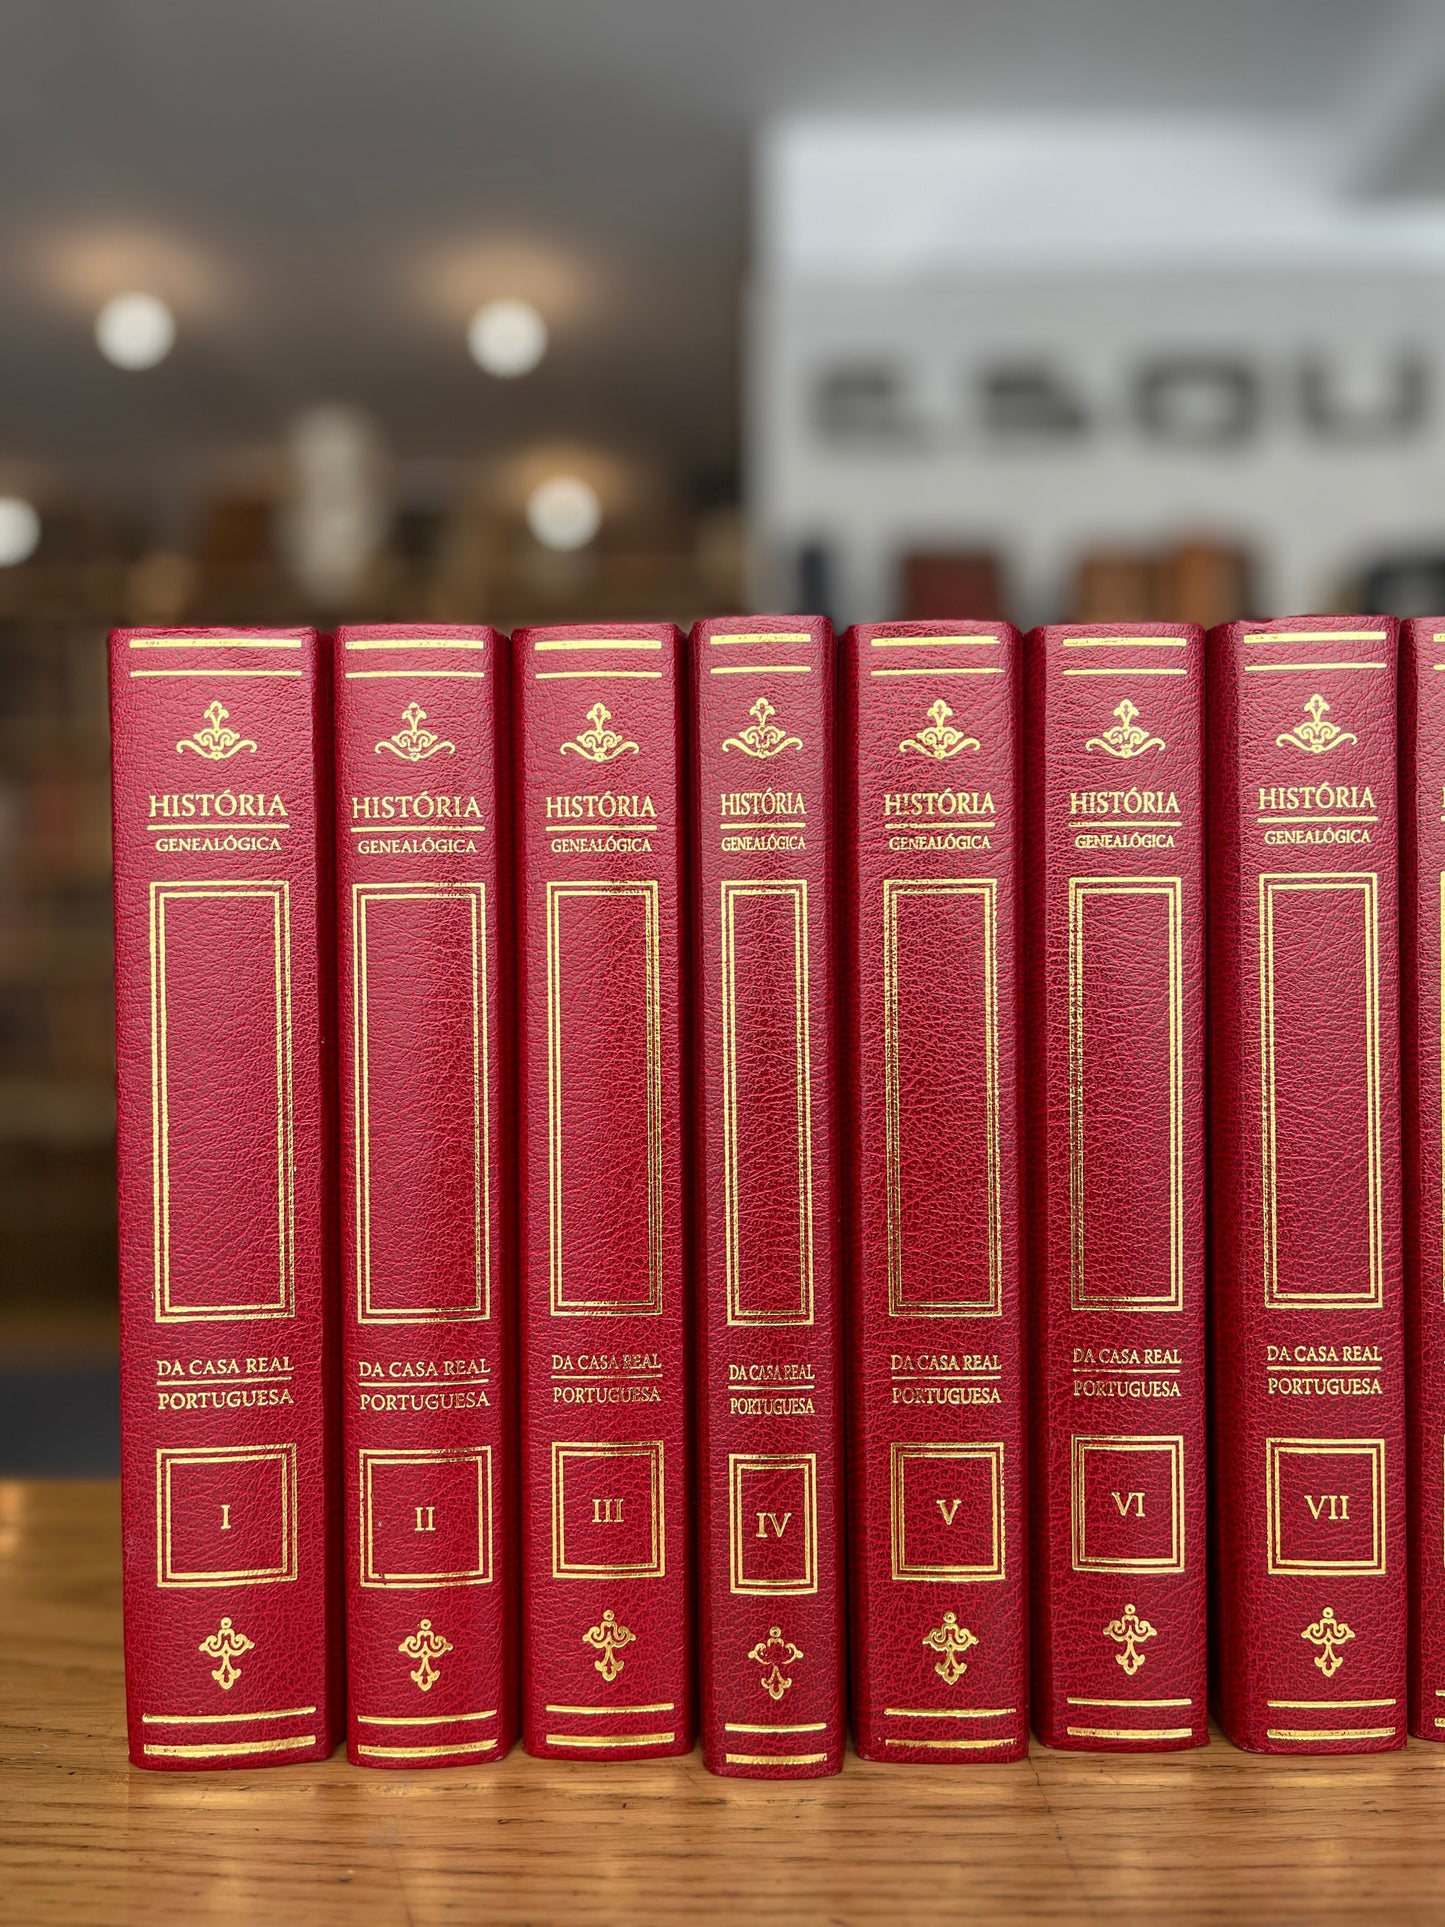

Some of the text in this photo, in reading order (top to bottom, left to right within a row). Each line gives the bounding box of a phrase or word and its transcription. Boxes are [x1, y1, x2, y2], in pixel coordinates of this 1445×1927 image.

[149, 790, 288, 817] HISTÓRIA
[352, 791, 483, 819] HISTÓRIA
[546, 791, 657, 818] HISTÓRIA
[720, 787, 807, 816] HISTÓRIA
[883, 788, 996, 815] HISTÓRIA
[1070, 787, 1180, 814] HISTÓRIA
[1258, 782, 1376, 810] HISTÓRIA
[155, 835, 282, 852] GENEALÓGICA
[358, 837, 477, 854] GENEALÓGICA
[551, 836, 652, 852] GENEALÓGICA
[721, 834, 806, 851] GENEALÓGICA
[889, 833, 992, 850] GENEALÓGICA
[1074, 832, 1175, 849] GENEALÓGICA
[1264, 827, 1371, 845] GENEALÓGICA
[551, 1353, 661, 1370] DA CASA REAL
[890, 1354, 1002, 1371] DA CASA REAL
[1073, 1348, 1182, 1365] DA CASA REAL
[1267, 1346, 1382, 1362] DA CASA REAL
[157, 1356, 294, 1376] DA CASA REAL
[359, 1358, 491, 1377] DA CASA REAL
[729, 1364, 815, 1381] DA CASA REAL
[553, 1386, 661, 1403] PORTUGUESA
[892, 1387, 1002, 1405] PORTUGUESA
[1073, 1380, 1181, 1397] PORTUGUESA
[1268, 1378, 1382, 1395] PORTUGUESA
[157, 1389, 294, 1410] PORTUGUESA
[360, 1391, 491, 1411] PORTUGUESA
[730, 1398, 815, 1415] PORTUGUESA
[591, 1498, 625, 1523] III
[936, 1499, 961, 1525] V
[1111, 1491, 1146, 1517] VI
[1304, 1494, 1350, 1520] VII
[221, 1504, 232, 1529] I
[414, 1507, 436, 1532] II
[756, 1512, 792, 1539] IV
